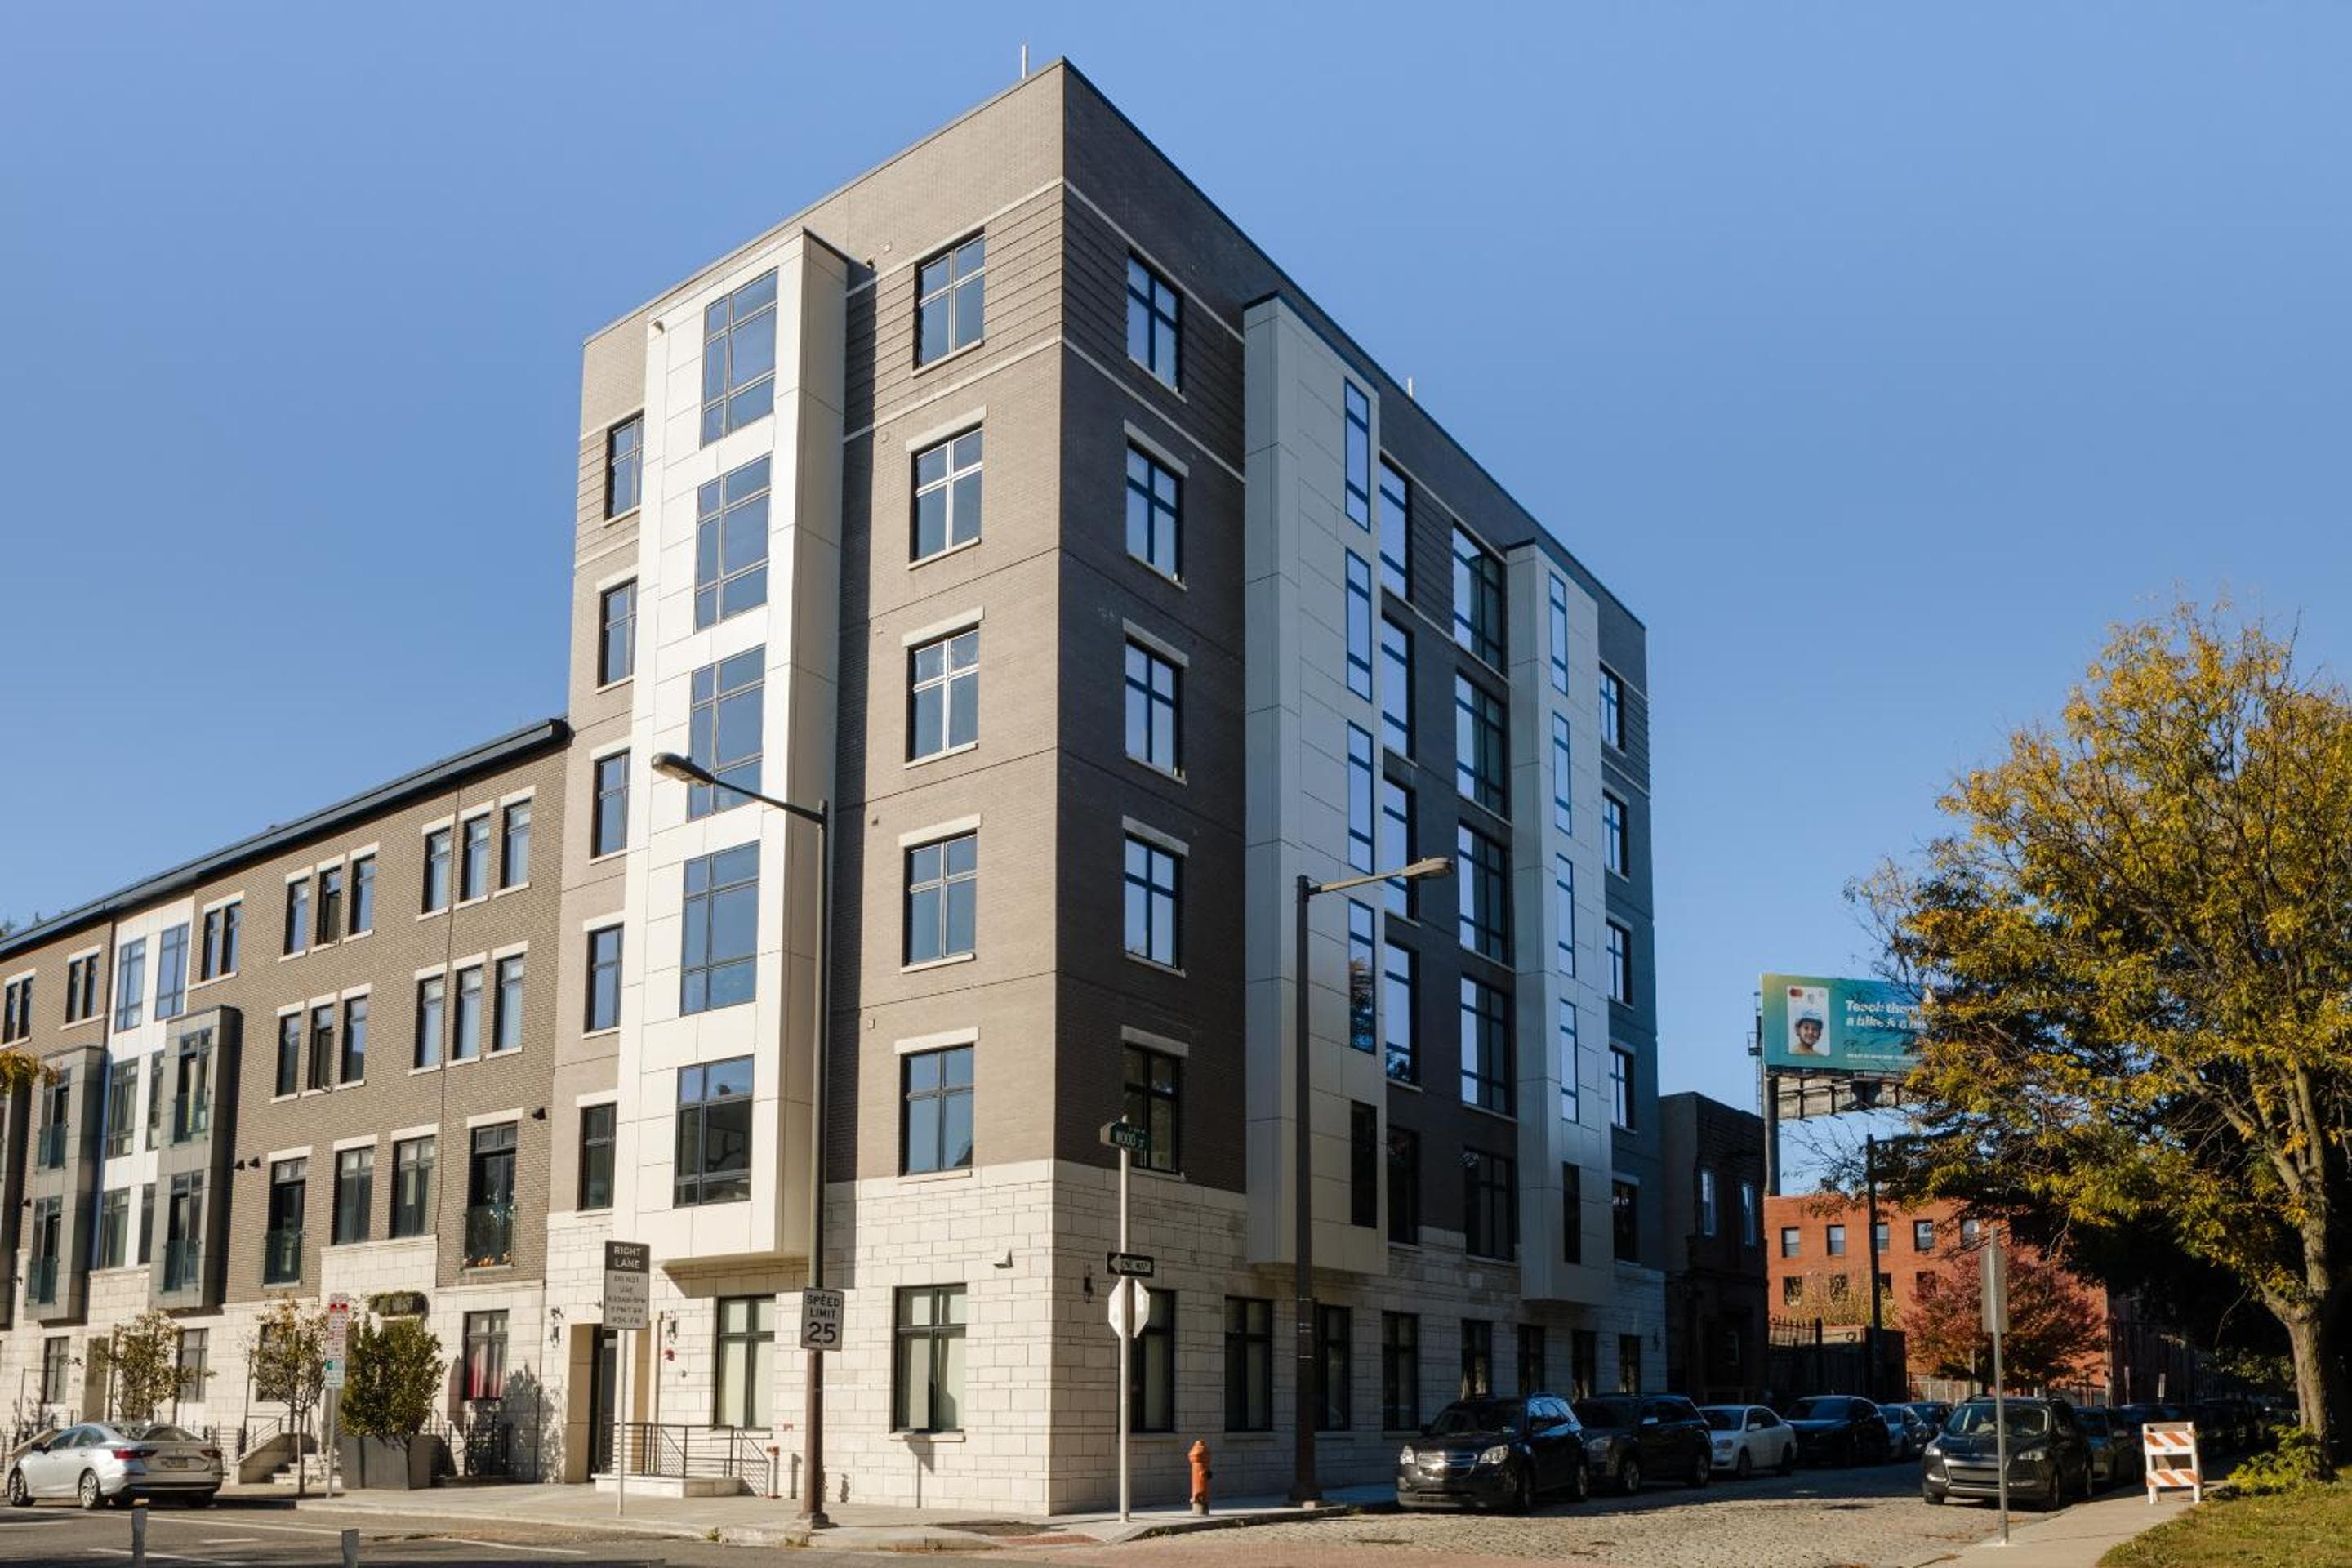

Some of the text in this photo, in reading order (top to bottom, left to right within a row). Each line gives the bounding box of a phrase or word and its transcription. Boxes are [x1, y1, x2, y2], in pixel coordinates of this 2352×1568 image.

[614, 1246, 641, 1256] RIGHT
[614, 1258, 640, 1269] LANE
[807, 1295, 840, 1307] SPEED
[810, 1307, 835, 1320] LIMIT
[809, 1321, 835, 1343] 25
